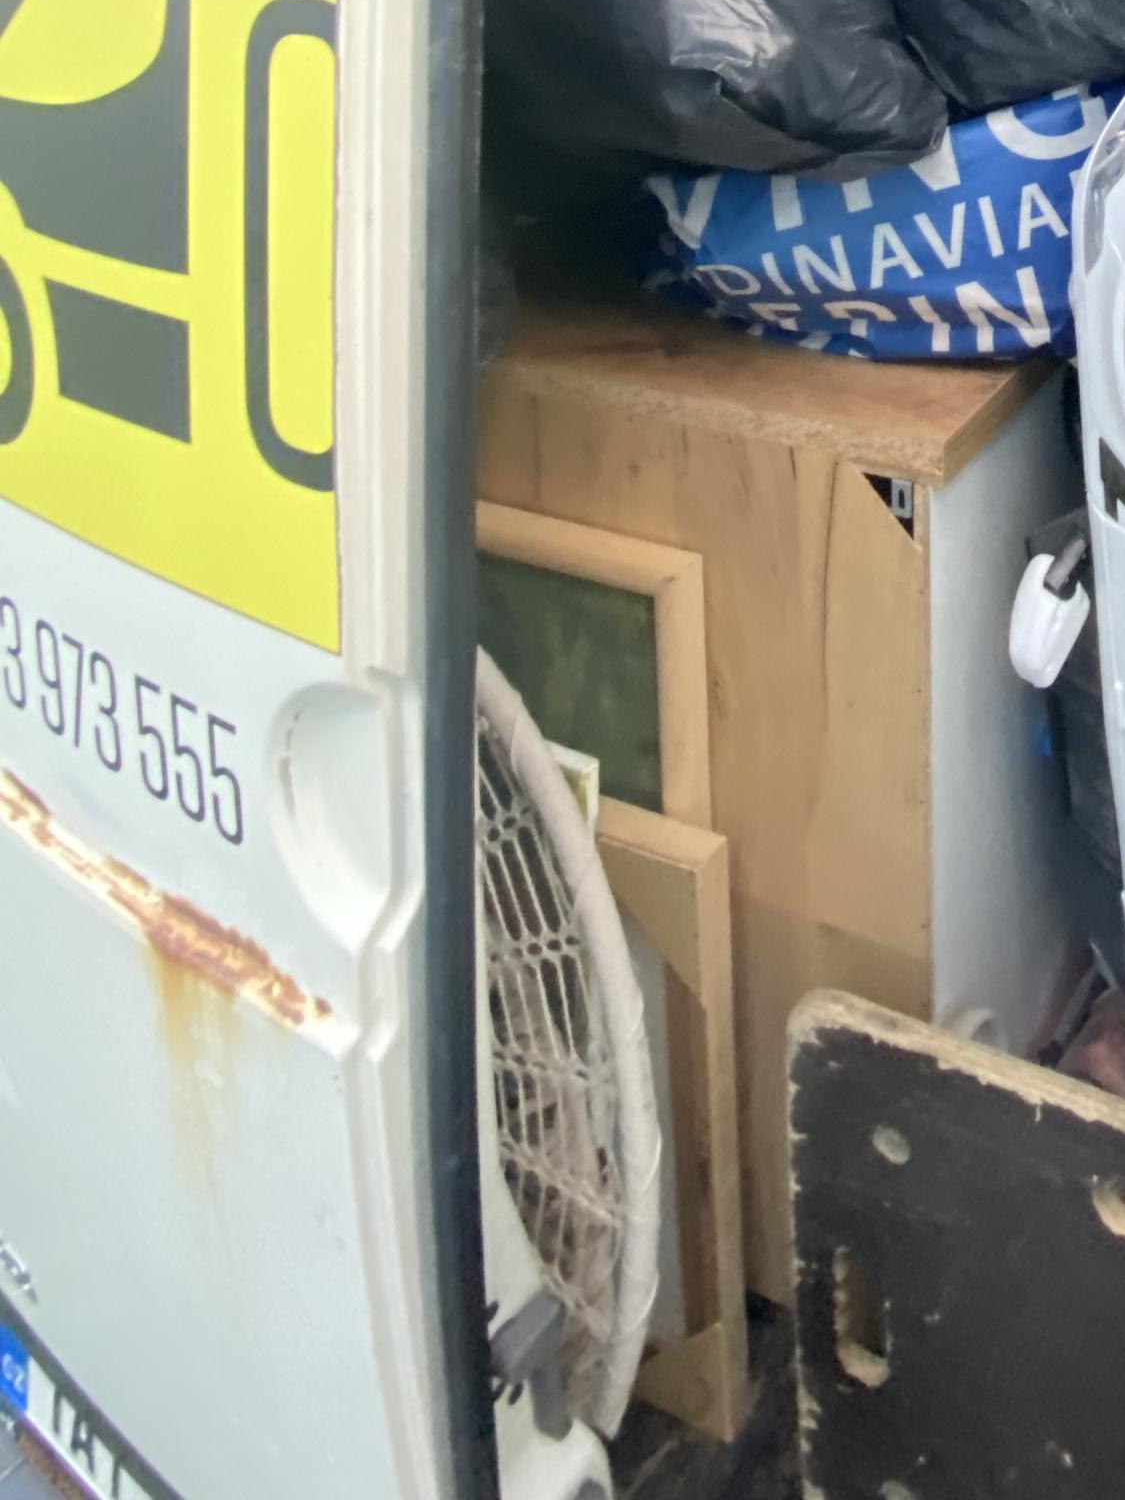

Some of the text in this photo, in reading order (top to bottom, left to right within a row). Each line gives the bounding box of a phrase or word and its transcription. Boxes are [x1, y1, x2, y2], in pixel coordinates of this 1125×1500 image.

[692, 168, 1078, 297] DINAVIA
[35, 619, 122, 773] 973
[134, 674, 244, 846] 555
